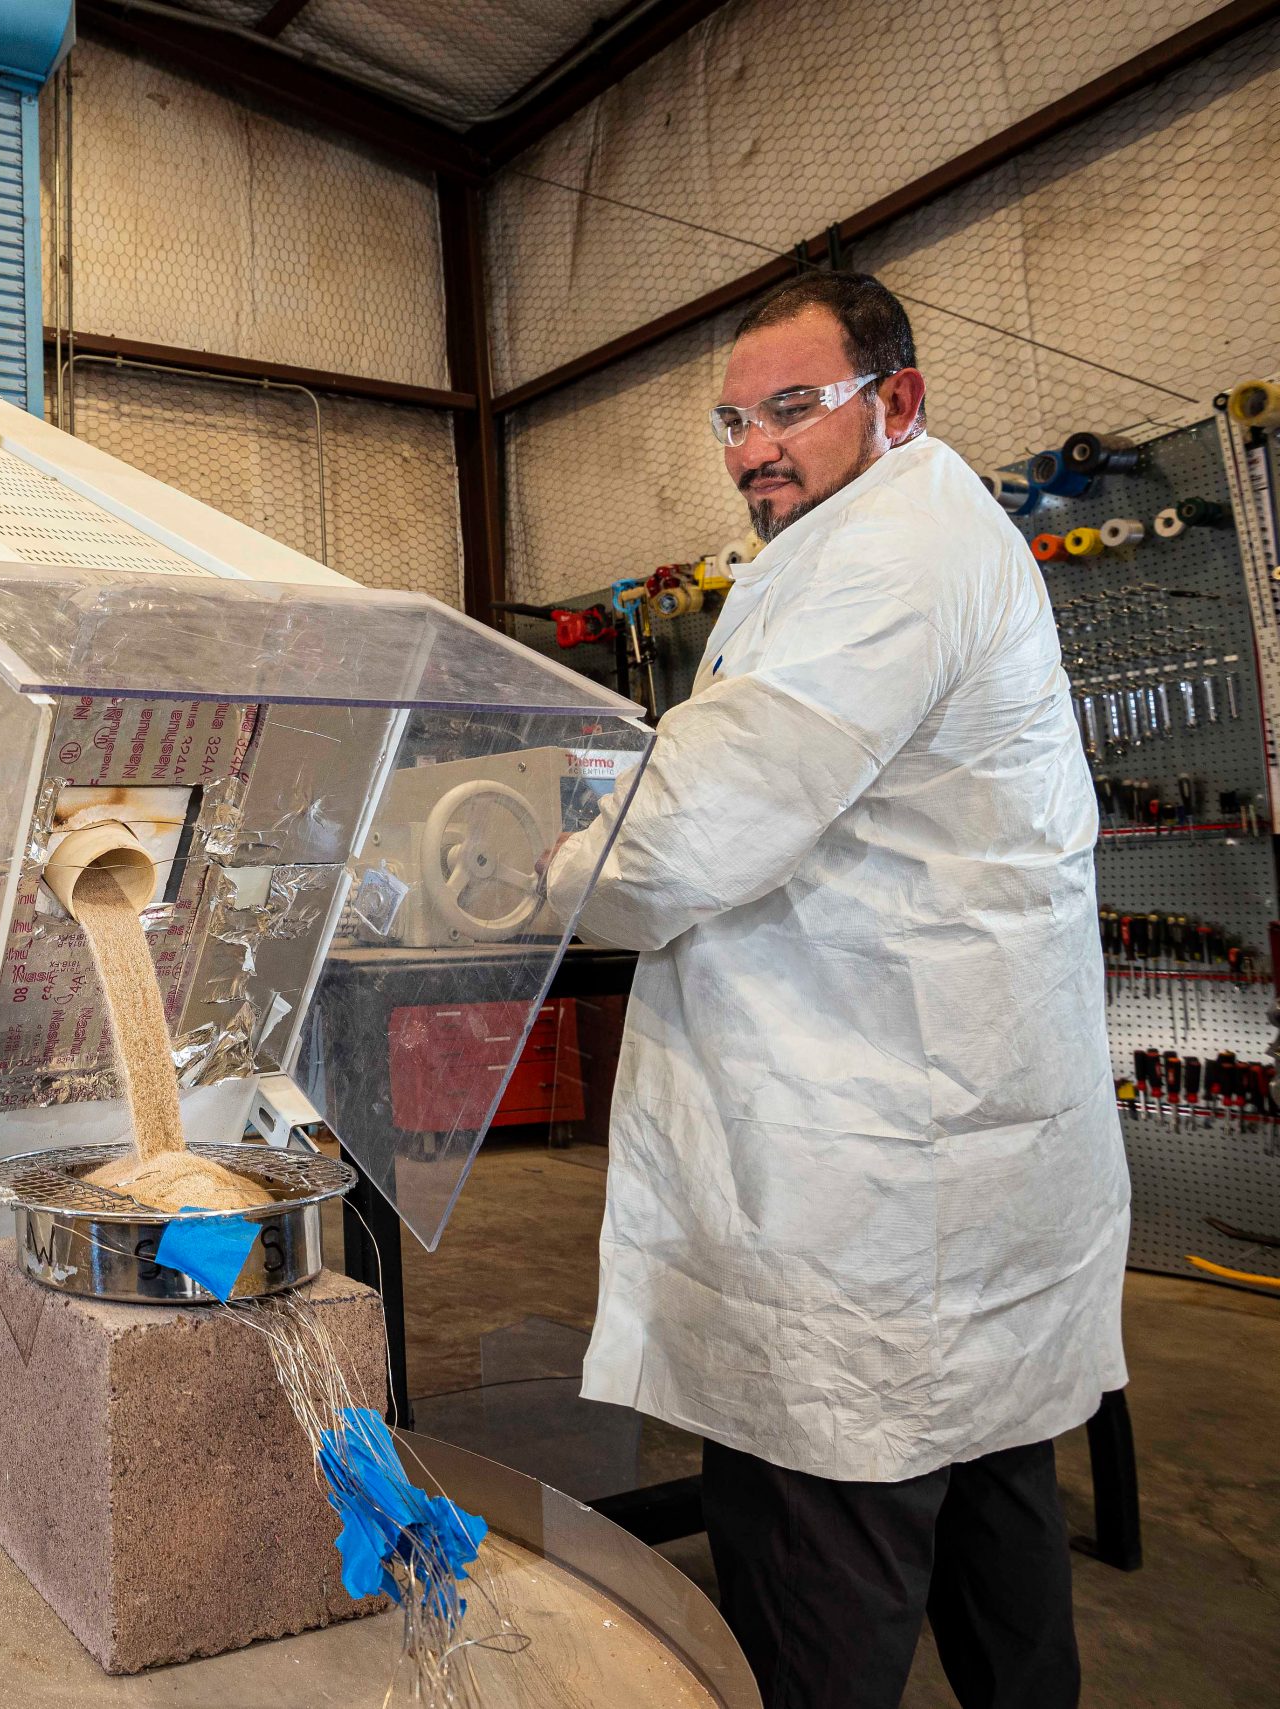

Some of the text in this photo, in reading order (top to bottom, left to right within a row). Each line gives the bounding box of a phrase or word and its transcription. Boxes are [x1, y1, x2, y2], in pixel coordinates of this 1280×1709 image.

[122, 709, 153, 778] Nashua
[151, 710, 183, 778] Nashua
[200, 736, 221, 775] 324A
[228, 738, 247, 777] 324A
[565, 753, 615, 768] Thermo
[568, 768, 615, 776] SCIENTIFIC
[27, 1221, 55, 1267] W
[261, 1225, 285, 1273] S
